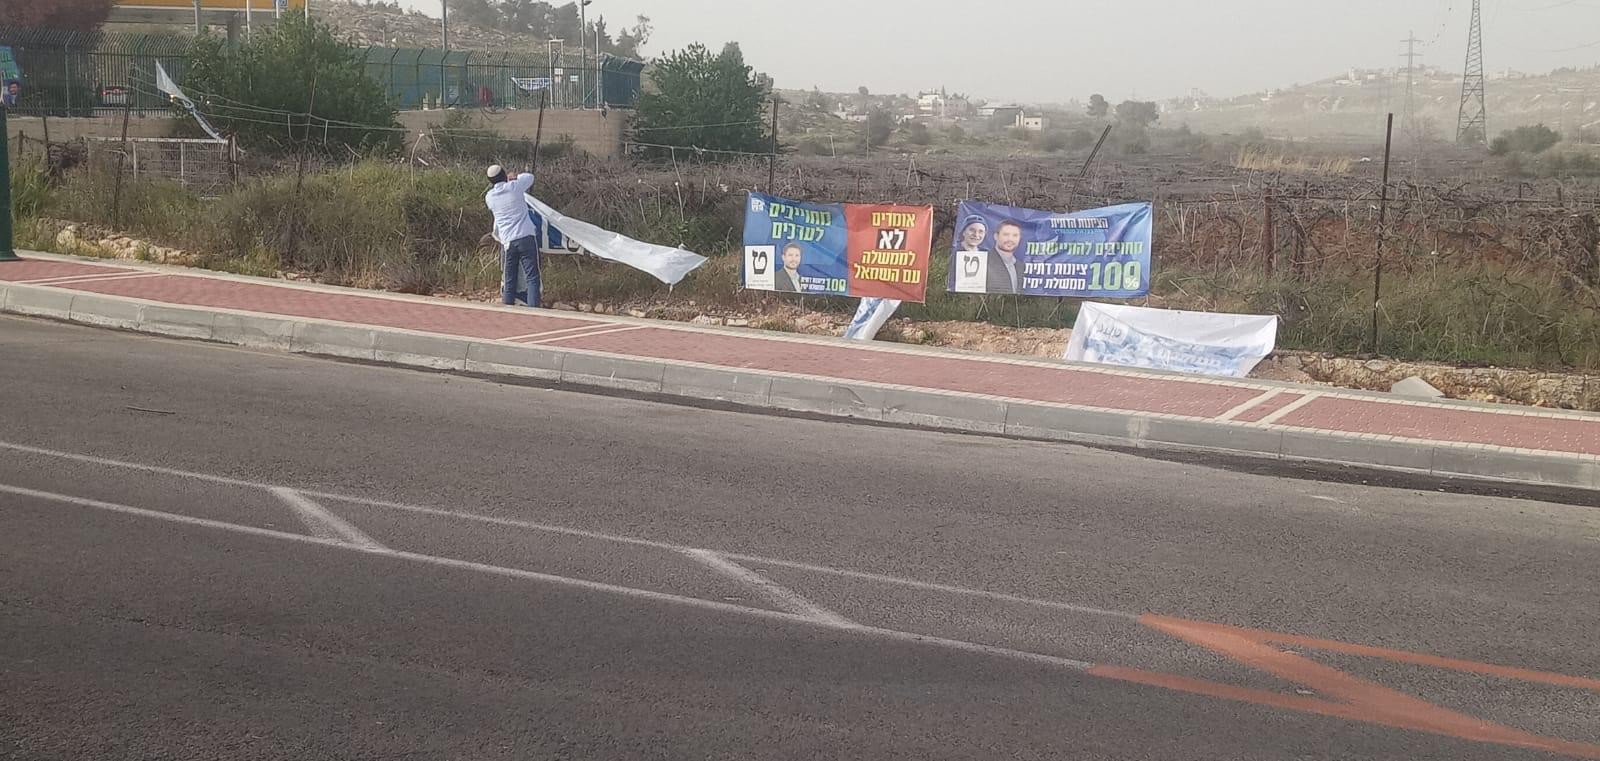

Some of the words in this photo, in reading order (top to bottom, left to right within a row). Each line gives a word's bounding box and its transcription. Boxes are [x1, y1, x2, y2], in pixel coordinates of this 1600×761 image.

[872, 212, 916, 228] אומרים
[772, 221, 825, 242] לערכים
[878, 228, 905, 250] לא
[752, 248, 768, 275] ט
[861, 250, 916, 267] לממשלה
[963, 254, 980, 278] ט
[853, 263, 900, 283] השמאל
[902, 269, 921, 284] עם
[1023, 262, 1052, 275] דתית
[1053, 262, 1088, 276] ציונות
[1022, 277, 1043, 290] ימין
[1044, 276, 1086, 290] ממשלת
